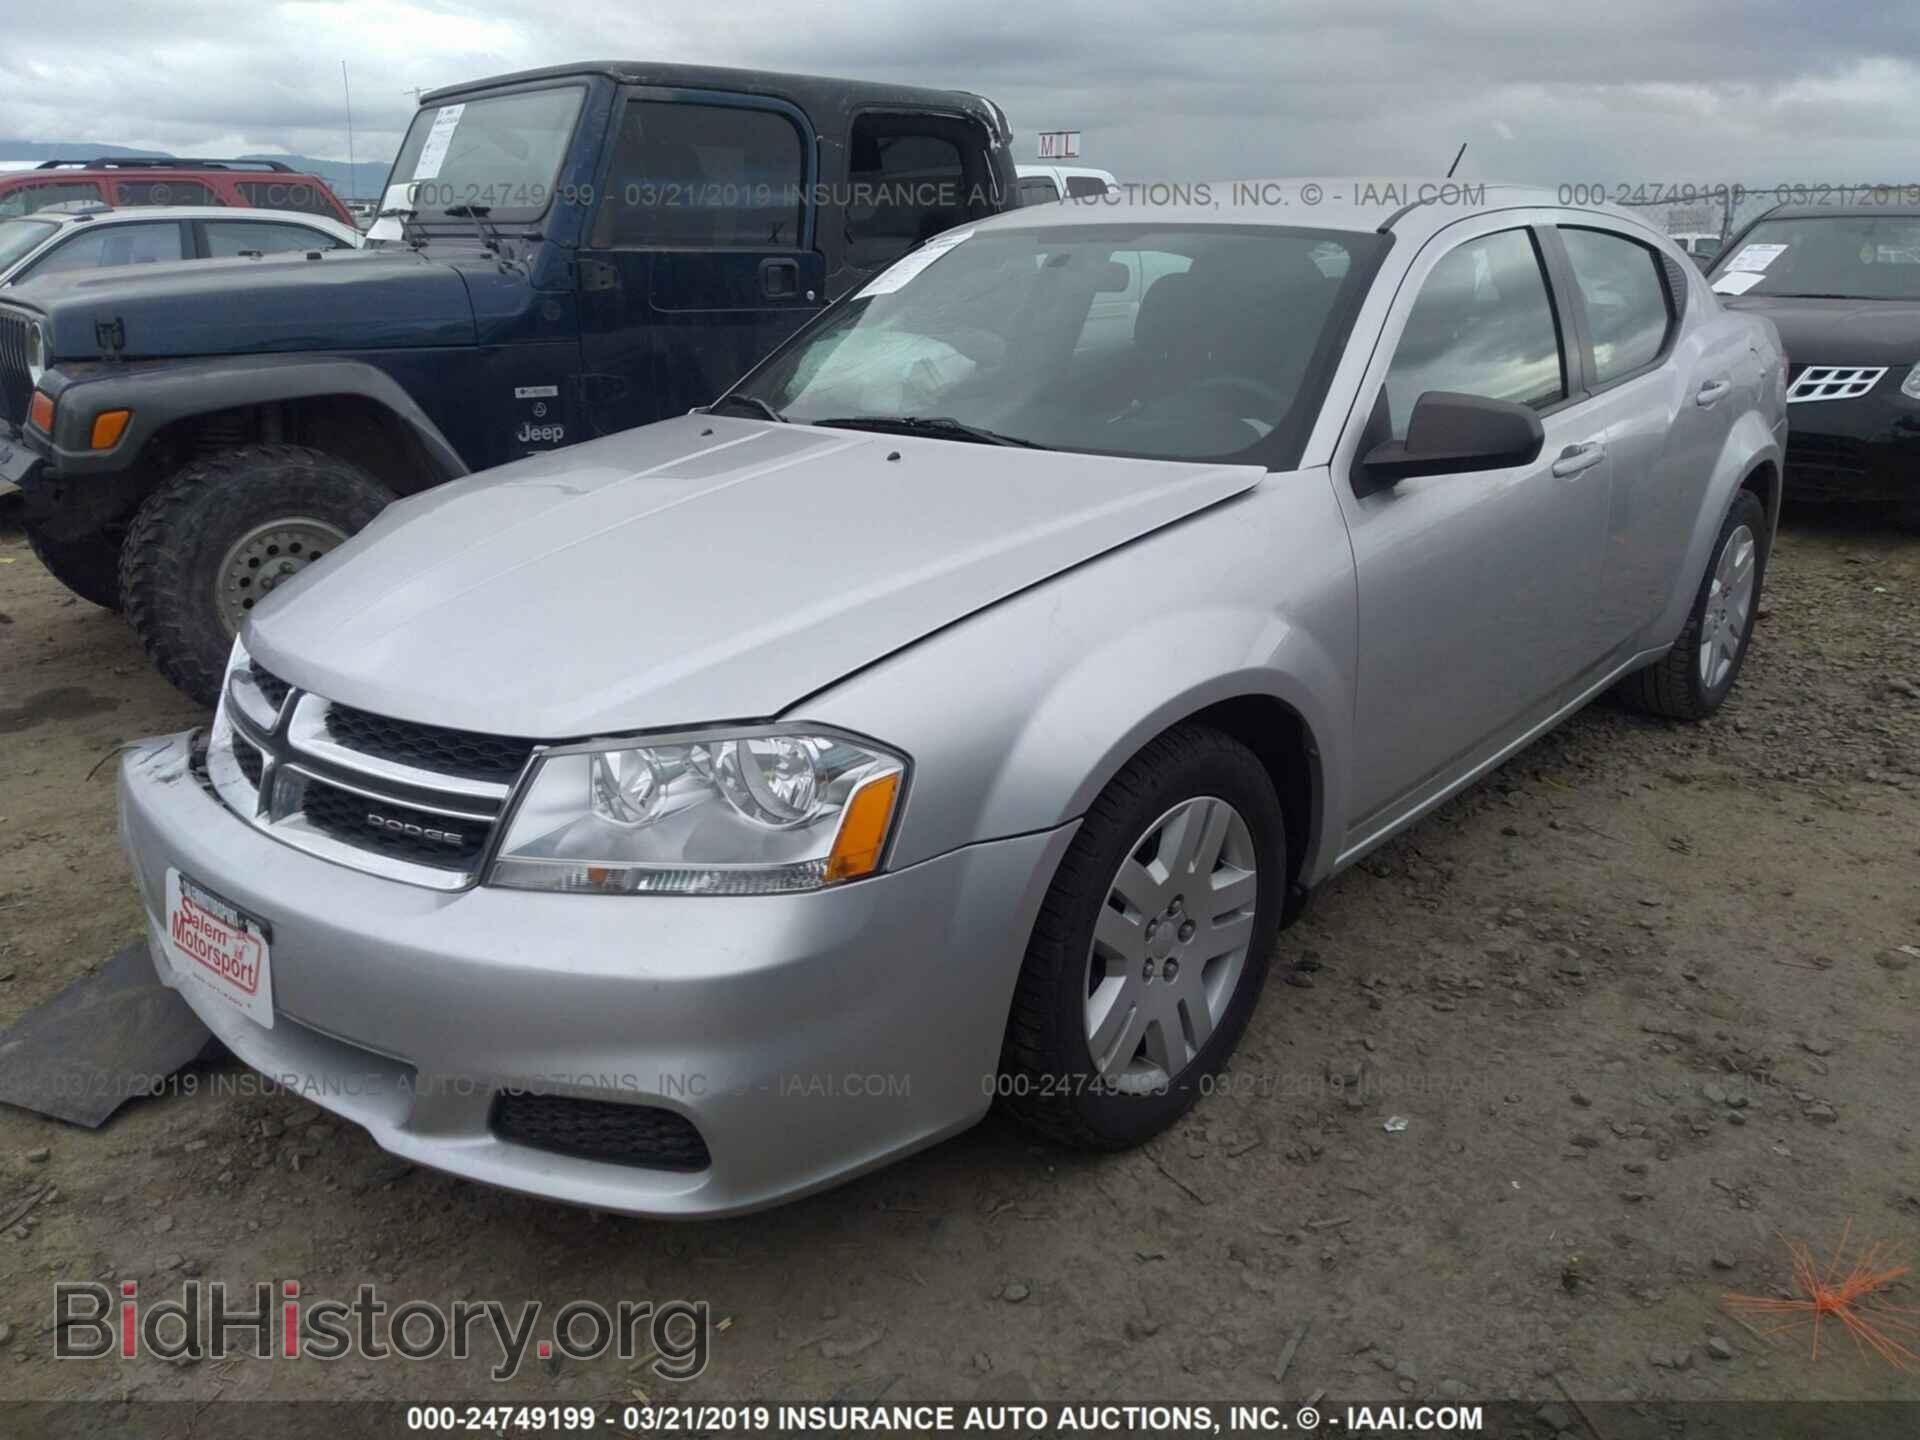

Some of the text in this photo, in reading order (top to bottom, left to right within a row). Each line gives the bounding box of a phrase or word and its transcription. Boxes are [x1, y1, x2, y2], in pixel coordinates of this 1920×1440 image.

[518, 423, 564, 443] Jeep
[367, 813, 463, 844] DODGE
[181, 896, 228, 945] Salem
[172, 911, 254, 988] Motorsport
